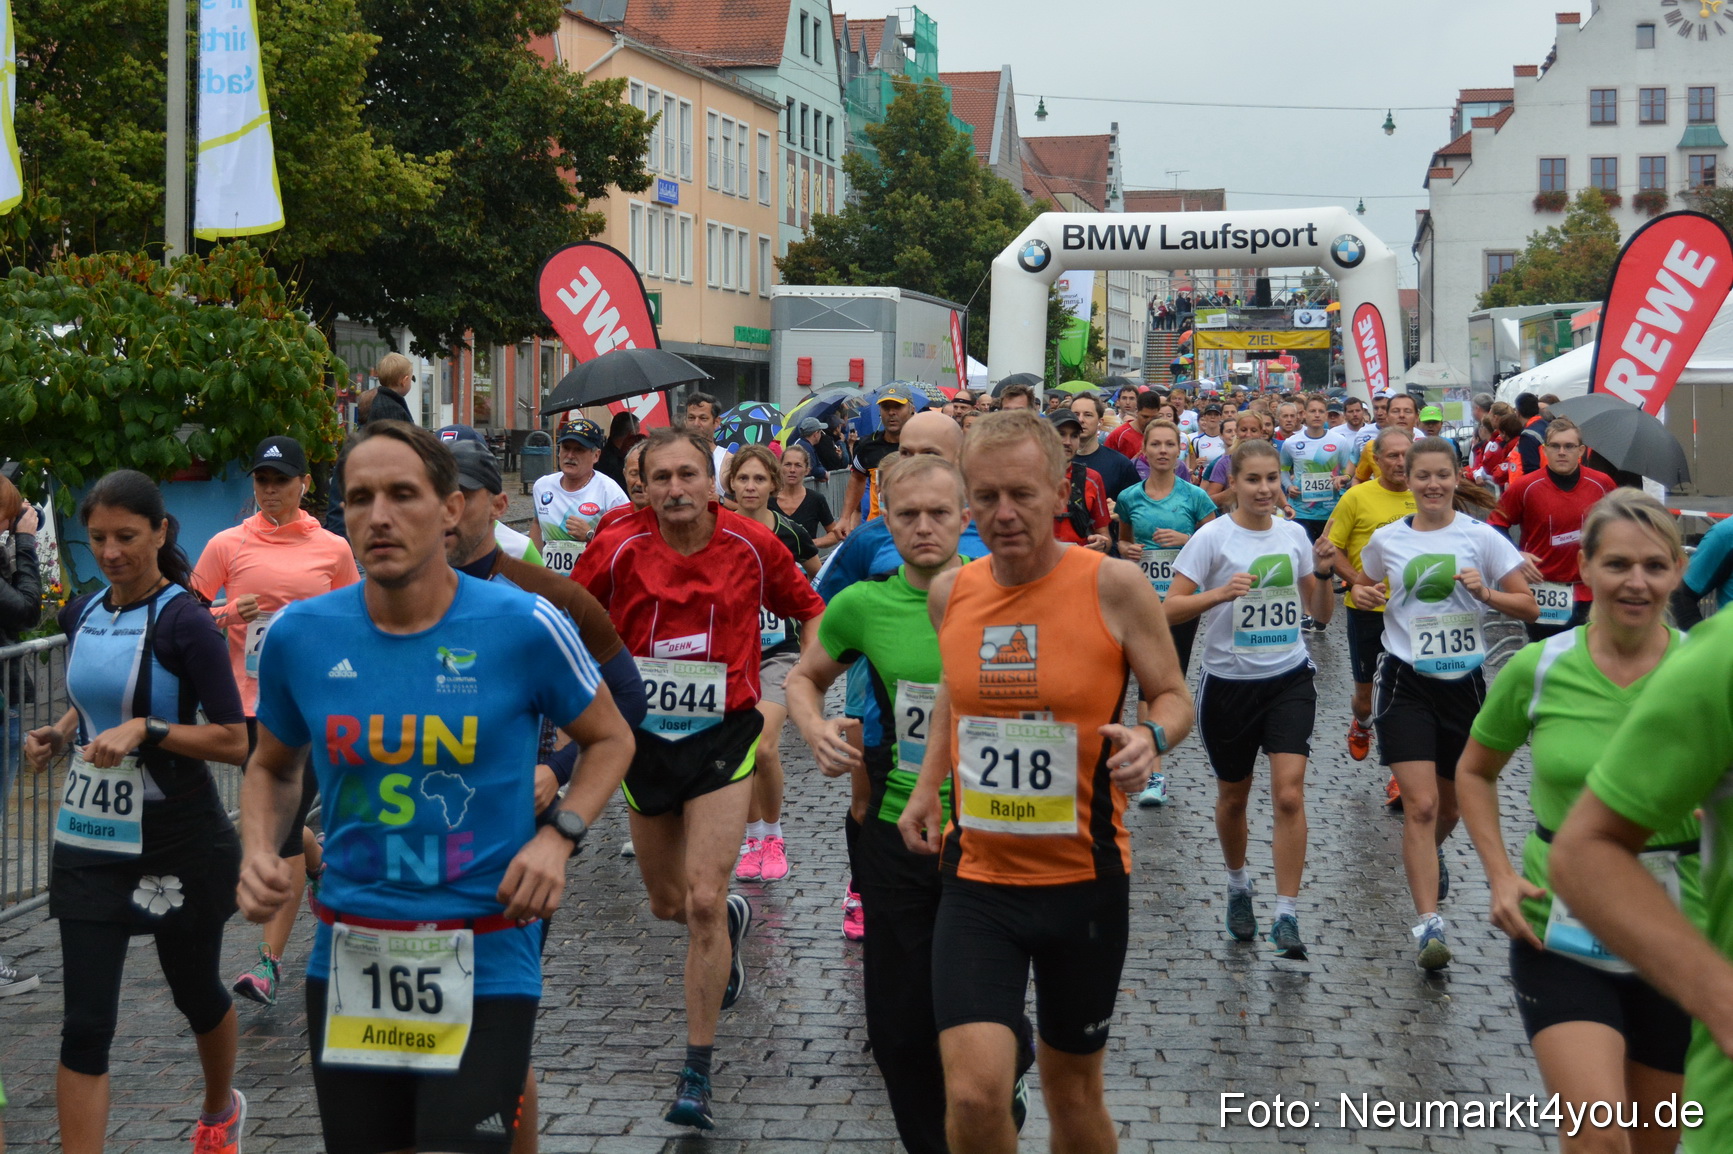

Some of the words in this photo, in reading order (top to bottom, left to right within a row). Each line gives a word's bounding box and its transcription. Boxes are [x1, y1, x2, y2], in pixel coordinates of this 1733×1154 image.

[1063, 224, 1151, 250] BMW
[1160, 222, 1318, 254] Laufsport
[1604, 239, 1717, 411] REWE
[1248, 334, 1278, 346] ZIEL
[1304, 480, 1331, 491] 2452
[1141, 561, 1176, 579] 266
[1241, 601, 1297, 628] 2136
[668, 641, 692, 652] DEHN
[1250, 634, 1288, 644] Ramona
[1419, 627, 1476, 655] 2135
[979, 671, 1038, 684] HIRSCH
[1435, 661, 1466, 671] Carina
[643, 679, 717, 713] 2644
[659, 718, 692, 731] Josef
[1005, 723, 1065, 738] BOCK
[325, 713, 478, 765] RUN
[979, 746, 1052, 790] 218
[64, 769, 134, 816] 2748
[338, 772, 416, 826] AS
[990, 799, 1036, 820] Ralph
[69, 816, 116, 838] Barbara
[362, 961, 444, 1015] 165
[361, 1024, 436, 1049] Andreas
